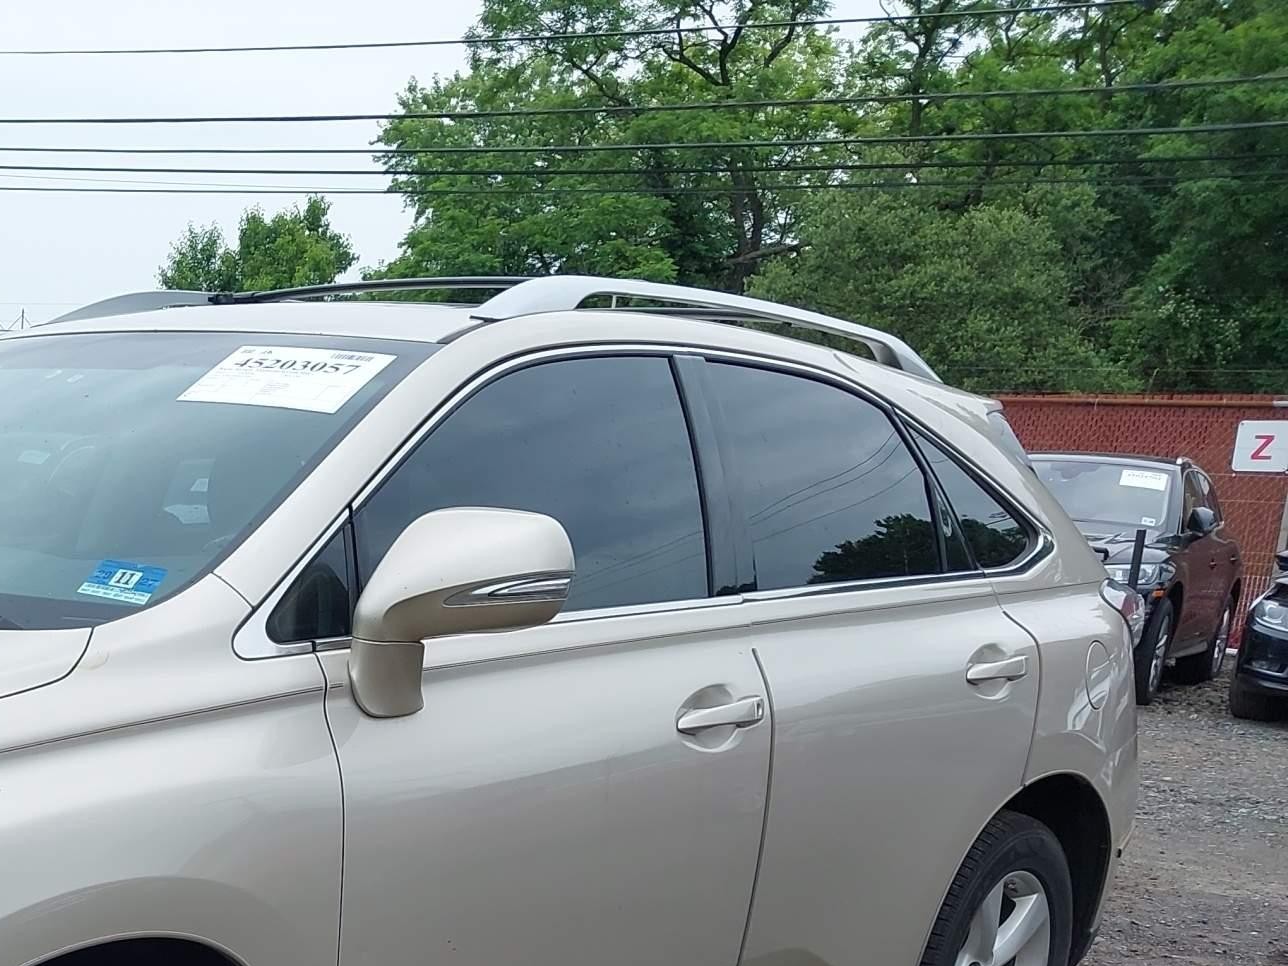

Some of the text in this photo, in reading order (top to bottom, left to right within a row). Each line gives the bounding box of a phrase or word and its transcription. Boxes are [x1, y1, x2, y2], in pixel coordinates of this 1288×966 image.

[234, 357, 361, 376] 45203057
[1250, 435, 1275, 461] Z
[114, 571, 137, 586] 11
